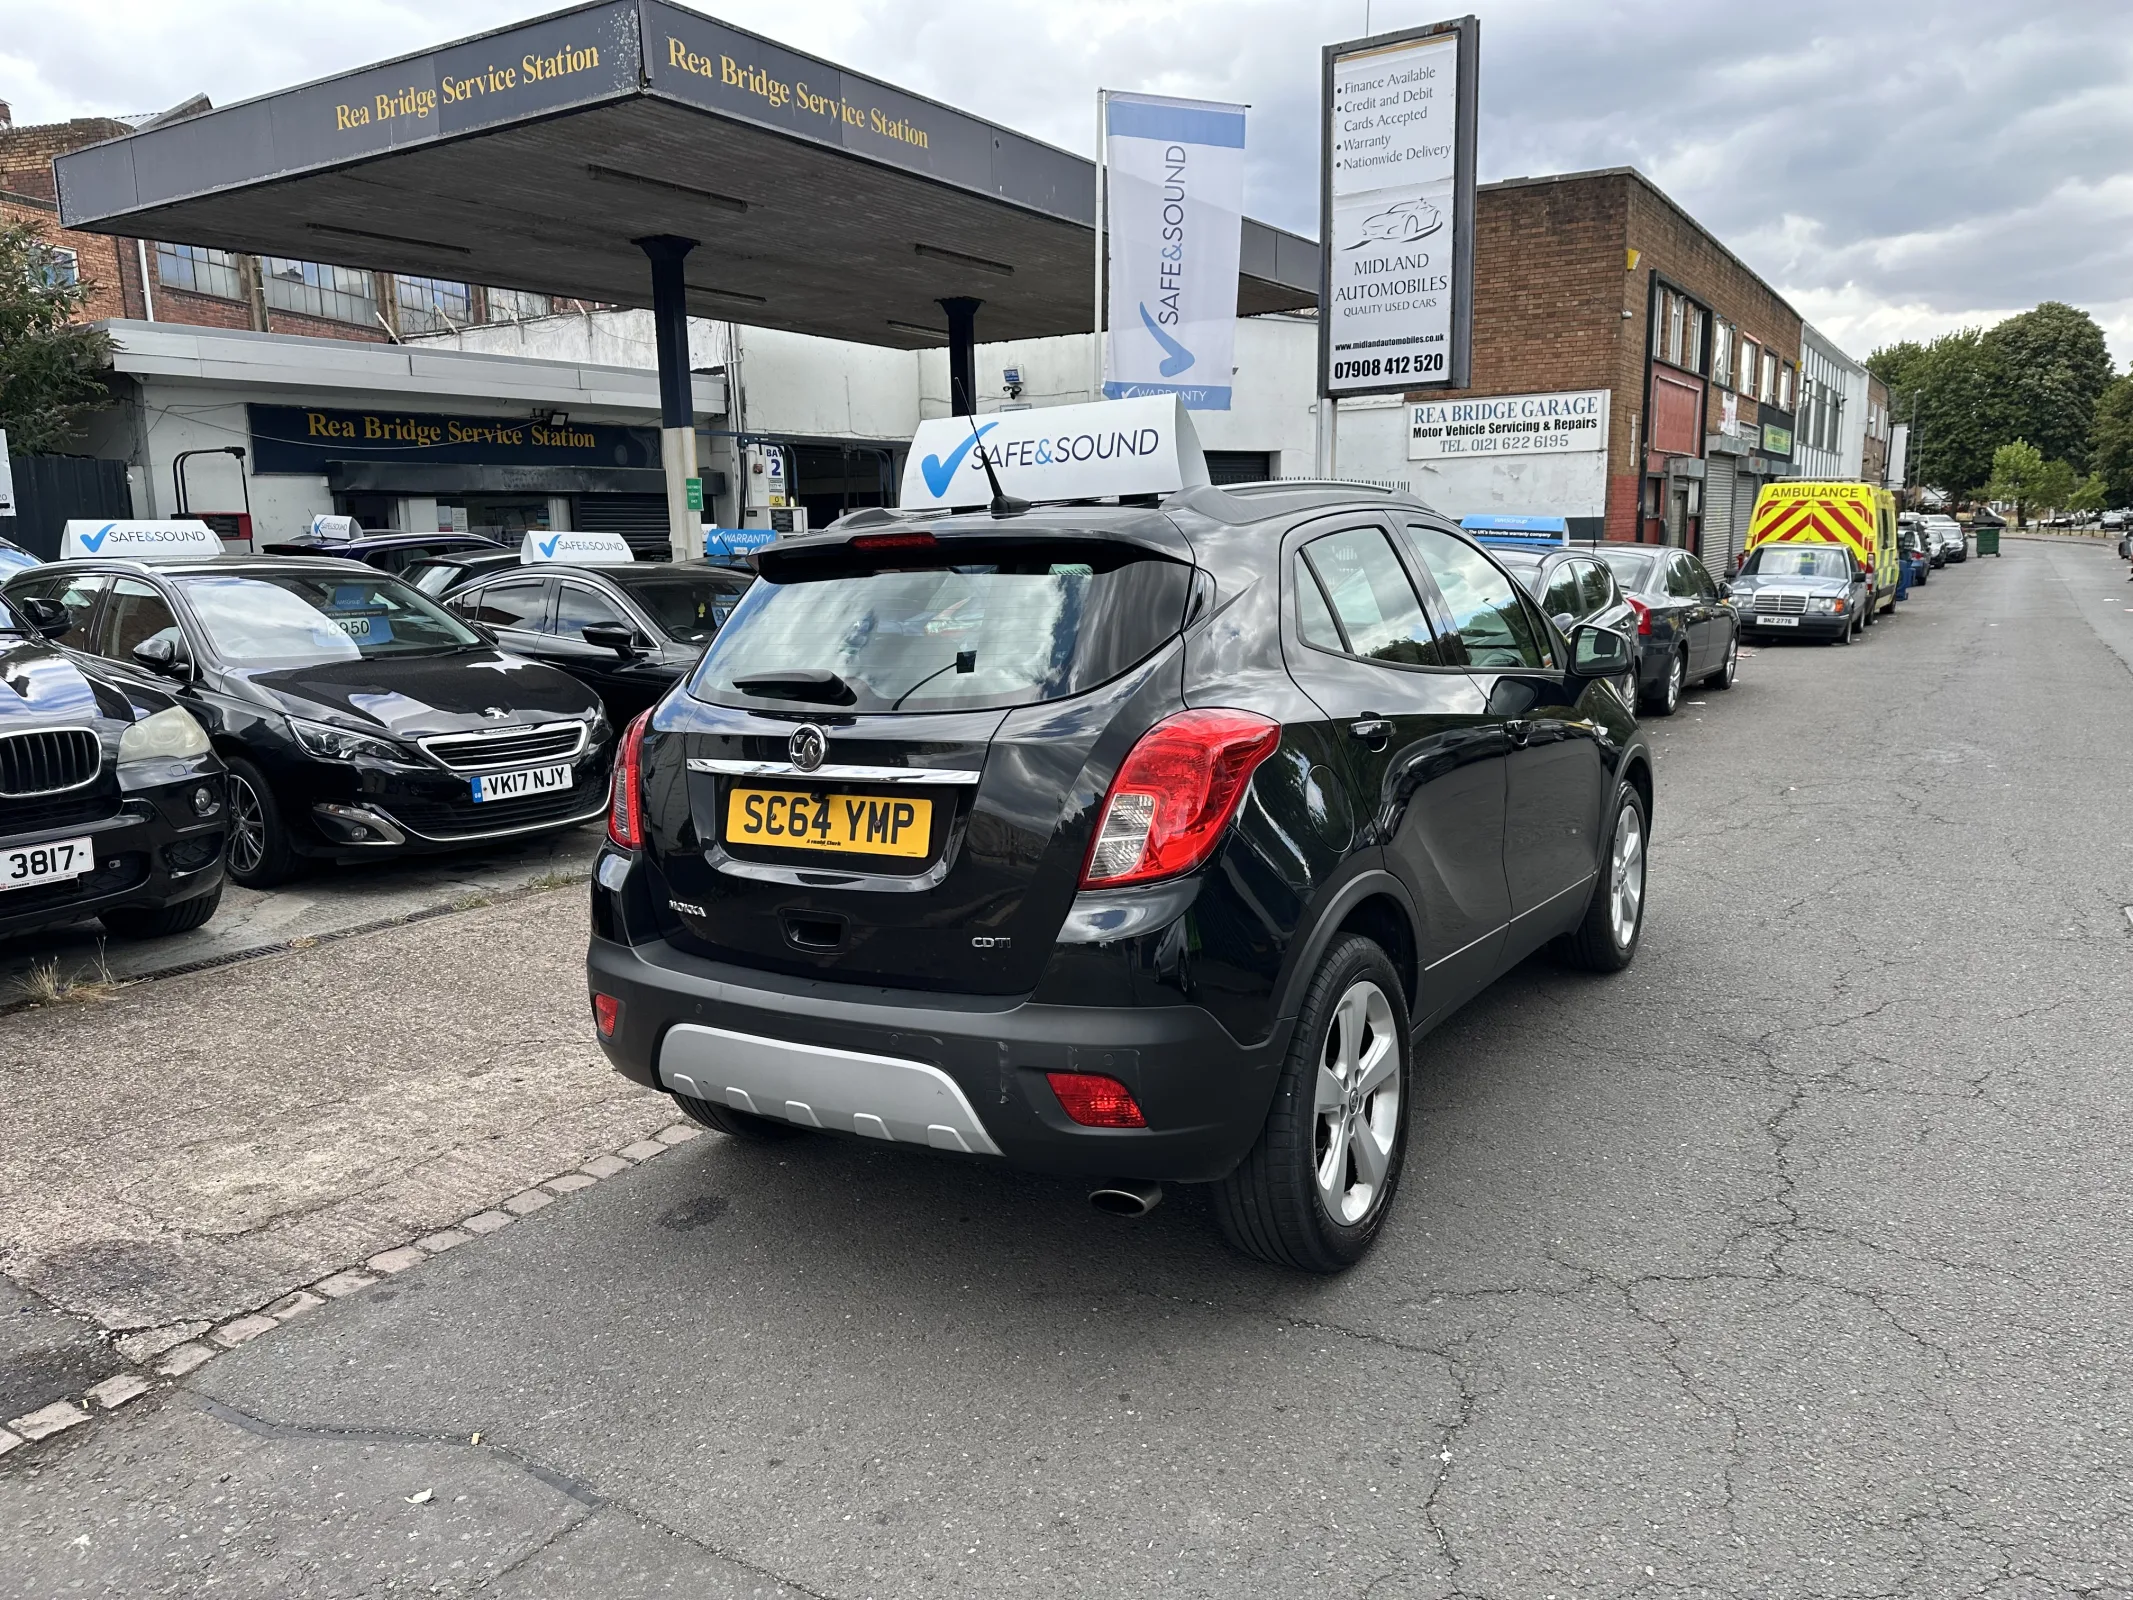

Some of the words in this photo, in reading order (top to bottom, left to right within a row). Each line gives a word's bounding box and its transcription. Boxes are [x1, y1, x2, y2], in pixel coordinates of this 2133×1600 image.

[336, 103, 371, 131] Rea
[375, 87, 438, 122] Bridge
[441, 64, 516, 104] Service
[522, 45, 599, 84] Station
[667, 36, 713, 78] Rea
[720, 54, 790, 107] Bridge
[796, 82, 866, 128] Service
[870, 108, 929, 149] Station
[1344, 77, 1384, 95] Finance
[1387, 66, 1436, 86] Available
[1344, 97, 1377, 113] Credit
[1380, 93, 1400, 107] and
[1403, 87, 1433, 103] Debit
[1344, 116, 1374, 132] Cards
[1376, 107, 1428, 127] Accepted
[1344, 134, 1391, 151] Warranty
[1343, 151, 1403, 170] Nationwide
[1406, 144, 1452, 161] Delivery
[1158, 145, 1187, 326] SAFE&SOUND
[1354, 253, 1429, 276] MIDLAND
[1335, 275, 1448, 302] AUTOMOBILES
[1343, 303, 1383, 317] QUALITY
[1385, 300, 1410, 312] USED
[1412, 297, 1437, 309] CARS
[1335, 333, 1444, 351] www.midlandautomobiles.co.uk
[1334, 358, 1381, 379] 07908
[1384, 356, 1410, 375] 412
[1413, 353, 1444, 372] 520
[1414, 407, 1447, 424] REA
[1451, 401, 1518, 422] BRIDGE
[1521, 396, 1598, 417] GARAGE
[306, 412, 355, 438] Rea
[364, 416, 440, 446] Bridge
[447, 421, 523, 446] Service
[530, 425, 596, 448] Station
[1413, 426, 1444, 439] Motor
[1446, 423, 1486, 437] Vehicle
[1488, 420, 1540, 435] Servicing
[1543, 420, 1551, 431] &
[1554, 417, 1598, 432] Repairs
[971, 428, 1159, 470] SAFE&SOUND
[1440, 439, 1467, 453] TEL.
[1471, 437, 1498, 452] 0121
[1502, 436, 1531, 450] 622
[1533, 434, 1569, 448] 6195
[771, 459, 781, 476] 2
[1771, 487, 1859, 498] AMBULANCE
[109, 531, 206, 542] SAFE&SOUND
[557, 533, 624, 552] SAFE&SOUND
[724, 533, 771, 544] WARRANTY
[328, 620, 370, 636] 3950
[488, 773, 528, 795] VK17
[533, 767, 564, 789] NJY
[743, 793, 832, 839] SC64
[845, 799, 915, 844] YMP
[9, 845, 74, 879] 3817
